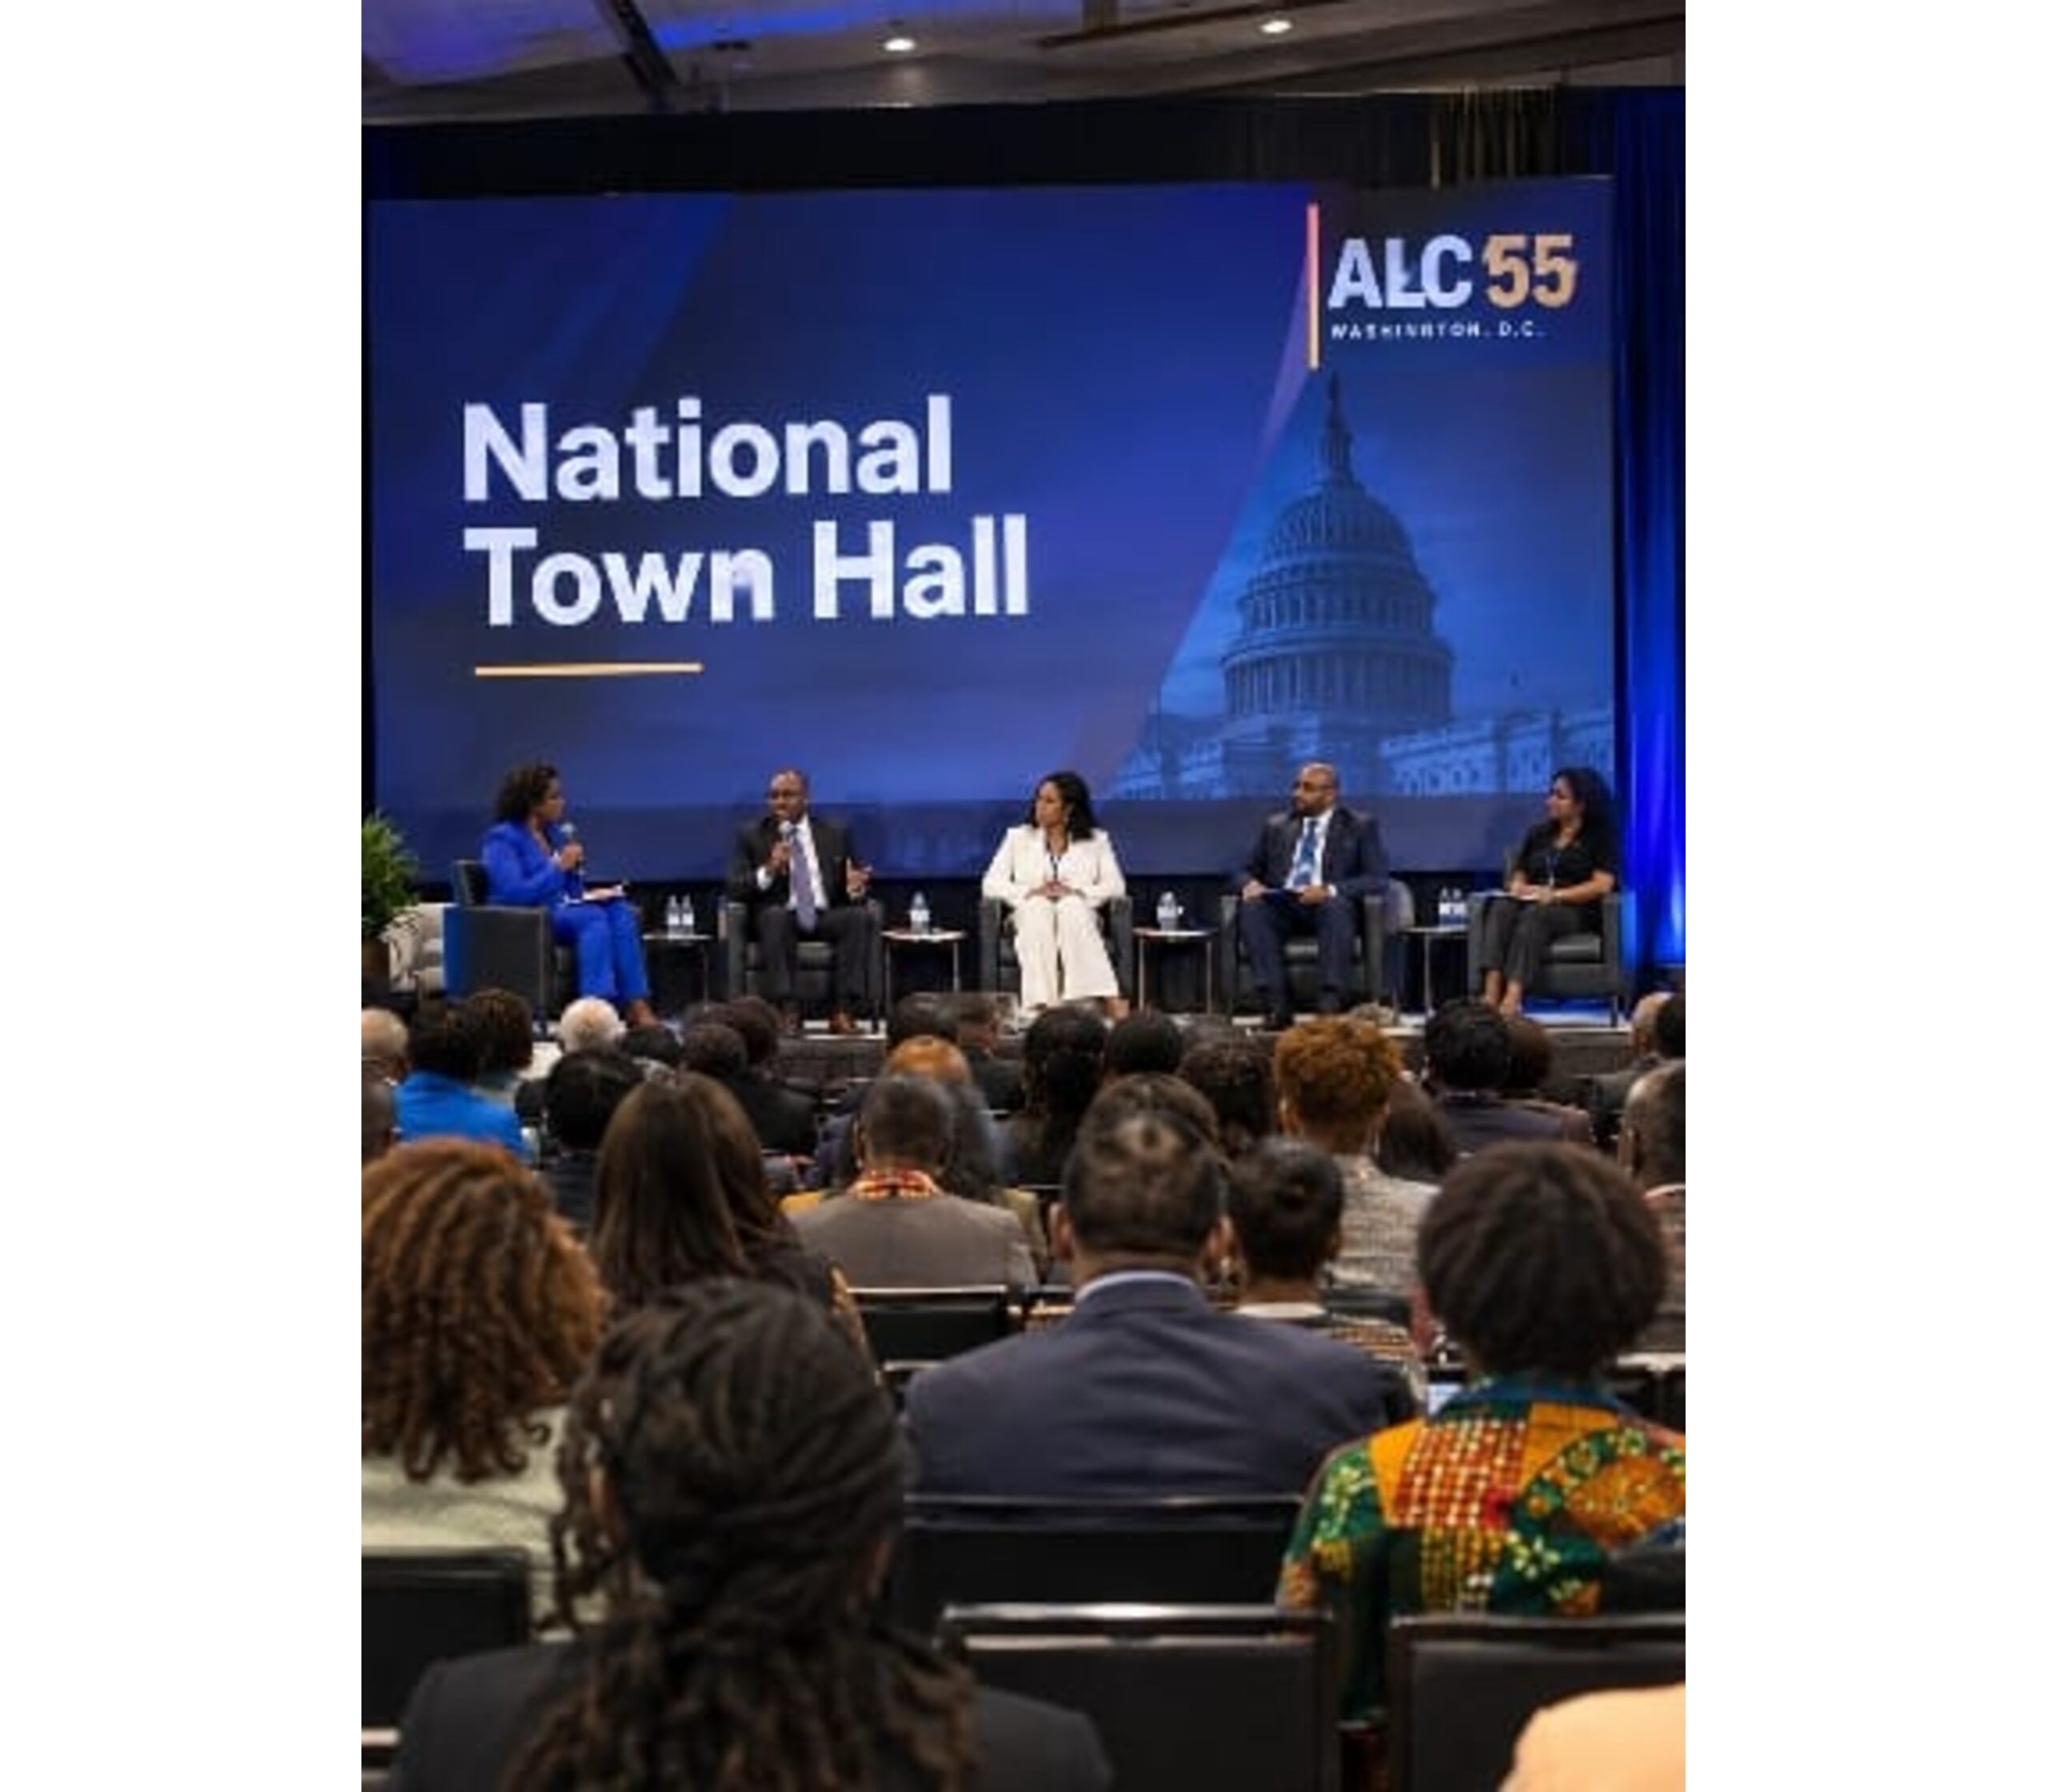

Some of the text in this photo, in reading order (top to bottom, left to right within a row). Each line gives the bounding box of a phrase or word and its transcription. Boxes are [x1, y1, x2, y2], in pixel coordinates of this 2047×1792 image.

[1327, 233, 1579, 309] ALC 55
[464, 394, 953, 501] National
[464, 513, 1029, 626] Town Hall
